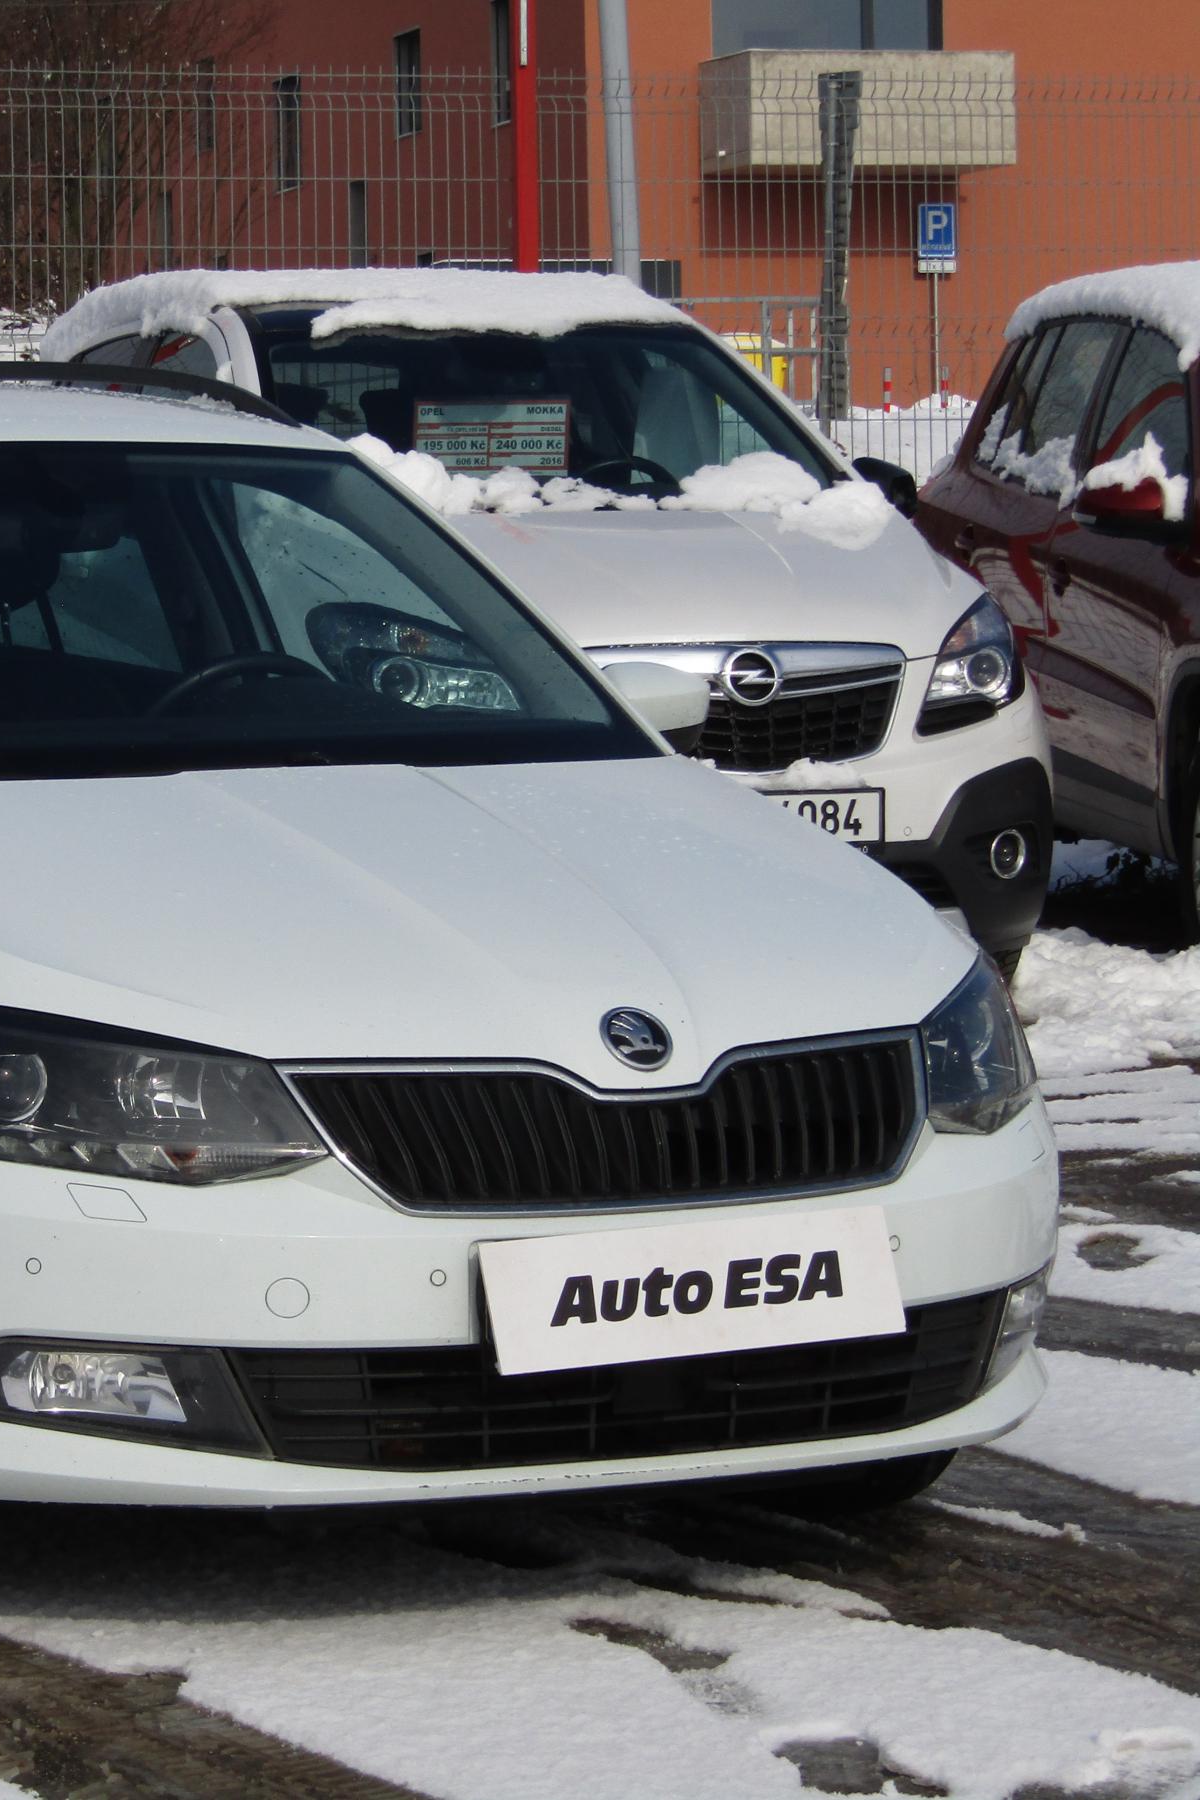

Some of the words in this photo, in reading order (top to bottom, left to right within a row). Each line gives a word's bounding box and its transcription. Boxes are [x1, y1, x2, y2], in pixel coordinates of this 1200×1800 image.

[927, 210, 948, 240] P
[420, 407, 445, 416] OPEL
[526, 406, 564, 415] MOKKA
[424, 441, 443, 451] 195
[447, 440, 467, 450] 000
[470, 439, 486, 450] Kč
[496, 440, 517, 450] 240
[521, 439, 542, 450] 000
[546, 439, 562, 450] Kč
[456, 457, 472, 466] 606
[540, 457, 562, 465] 2016
[550, 1266, 714, 1328] Auto
[723, 1249, 844, 1310] ESA
